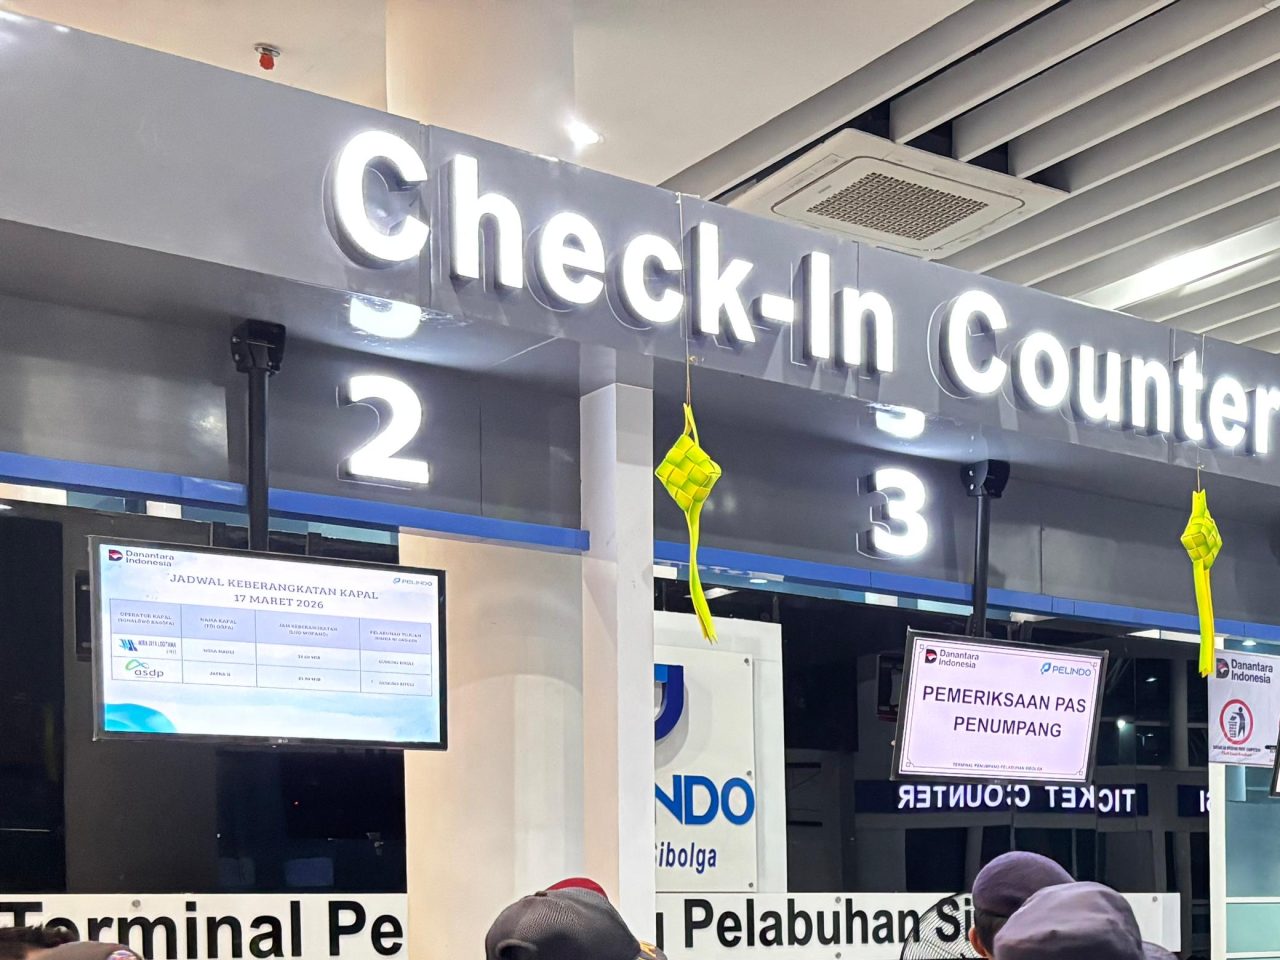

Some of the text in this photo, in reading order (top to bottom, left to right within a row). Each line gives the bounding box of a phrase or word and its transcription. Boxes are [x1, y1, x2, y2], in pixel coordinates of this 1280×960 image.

[332, 128, 896, 374] Check-In
[346, 374, 430, 485] 2
[871, 467, 929, 558] 3
[125, 550, 175, 561] Danantara
[125, 558, 173, 568] Indonesia
[169, 574, 379, 600] JADWAL KEBERANGKATAN KAPAL
[401, 578, 433, 587] PELINDO
[234, 594, 324, 610] 17 MARET 2026
[939, 649, 980, 661] Danantara
[938, 658, 976, 669] Indonesia
[1052, 665, 1092, 677] PELINDO
[1231, 658, 1273, 673] Danantara
[134, 668, 164, 679] asdp
[1231, 670, 1271, 684] Indonesia
[922, 685, 1087, 713] PEMERIKSAAN PAS
[953, 716, 1062, 738] PENUMPANG
[655, 841, 718, 874] ibolga
[684, 898, 921, 949] Pelabuhan
